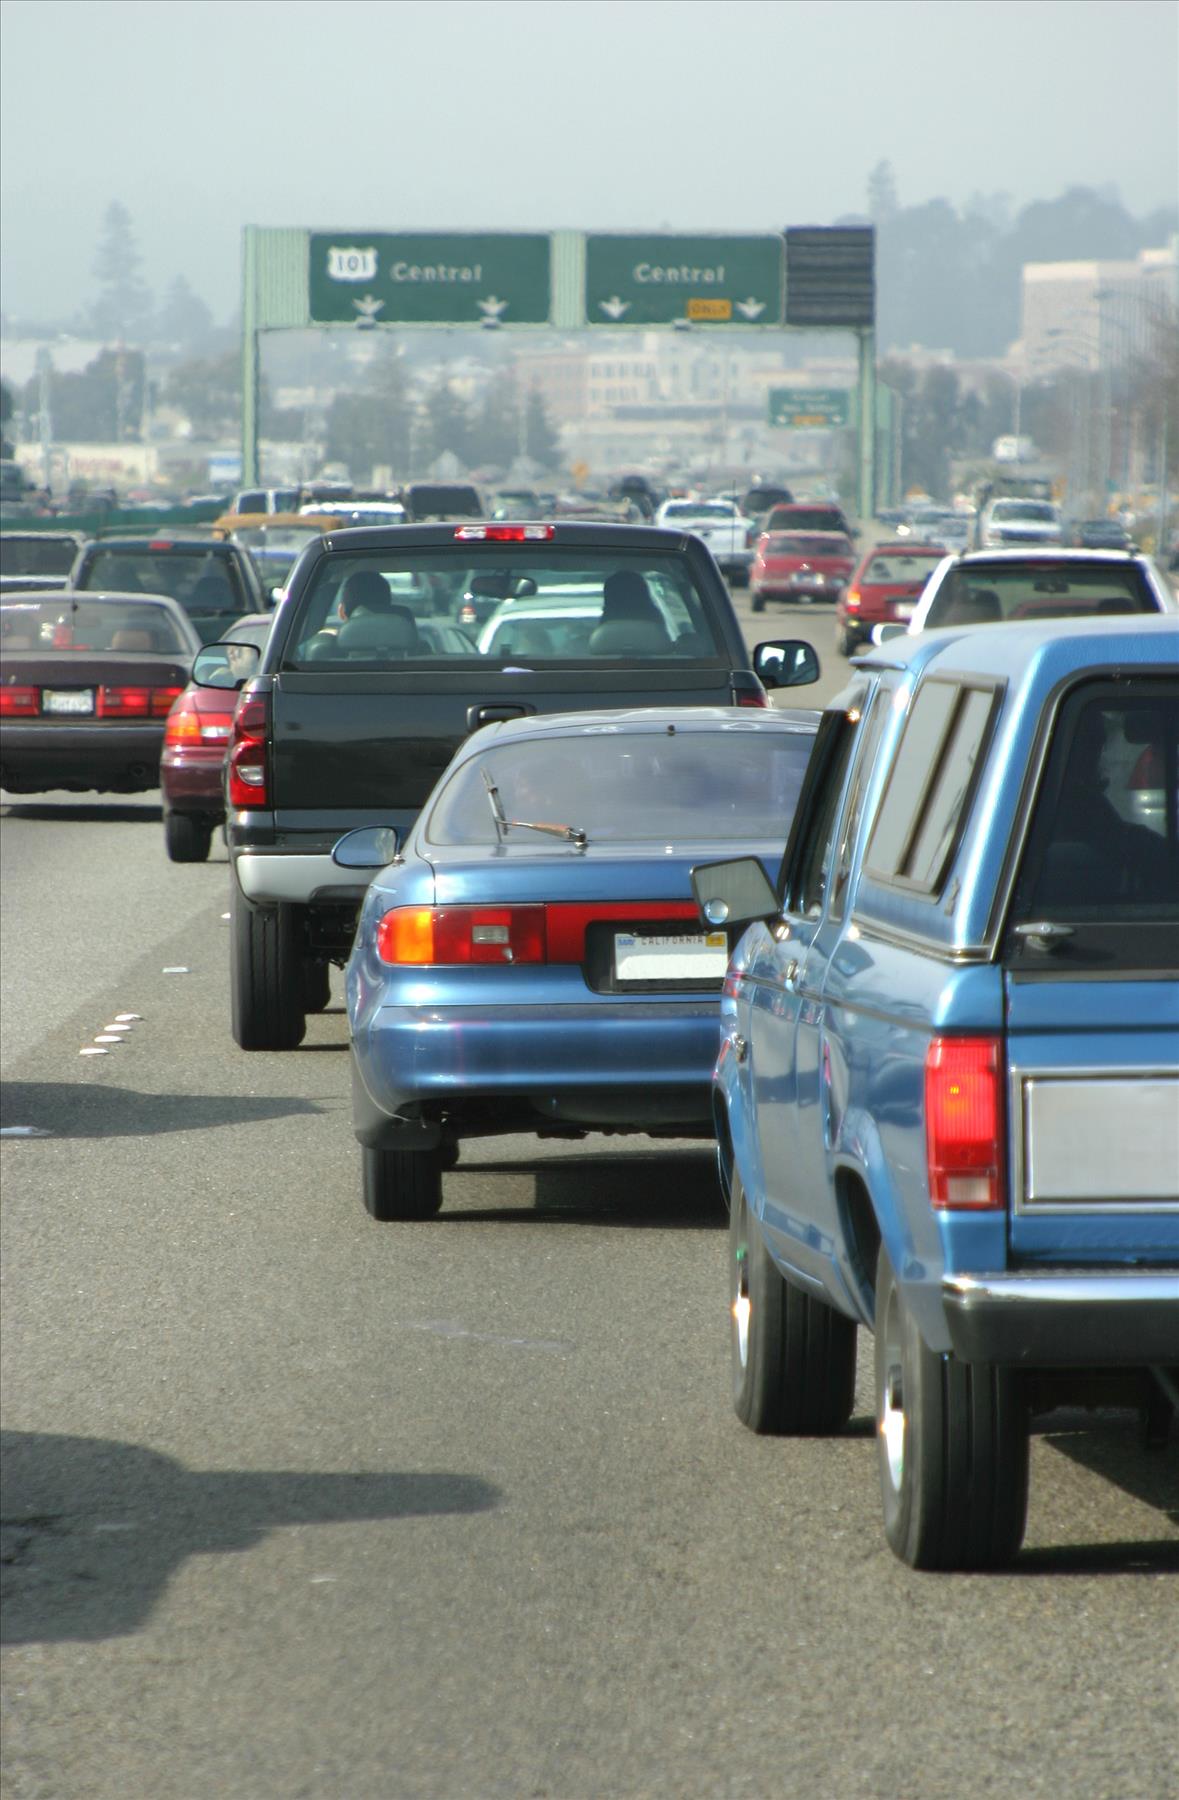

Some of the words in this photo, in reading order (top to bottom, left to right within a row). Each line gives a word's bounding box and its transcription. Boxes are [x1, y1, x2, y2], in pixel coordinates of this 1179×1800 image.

[336, 254, 369, 272] 101
[390, 261, 483, 282] Central
[632, 263, 726, 283] Central
[640, 934, 704, 946] CALIFORNIA
